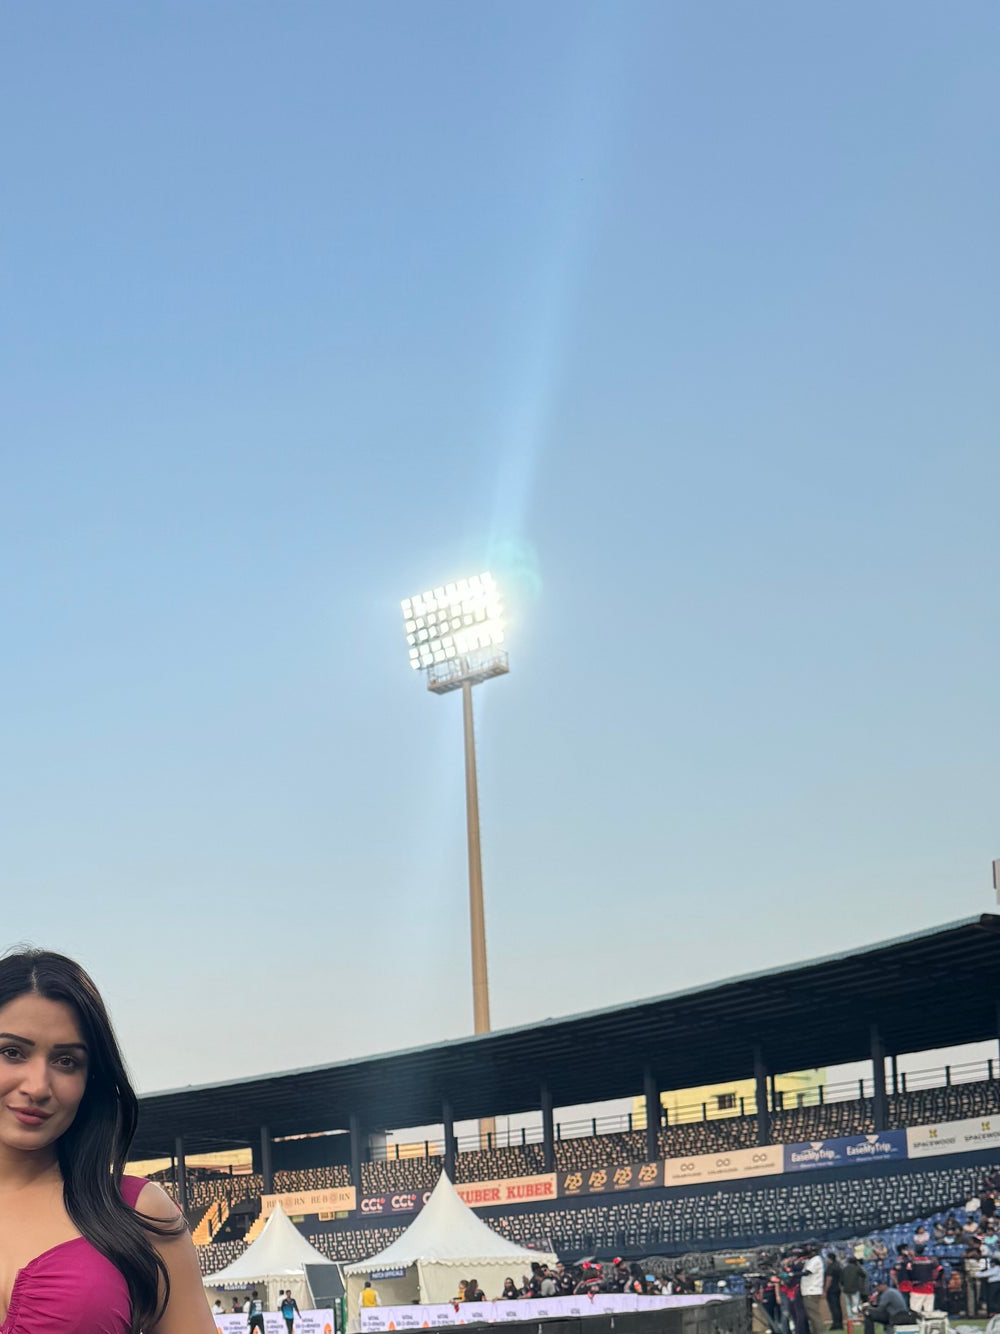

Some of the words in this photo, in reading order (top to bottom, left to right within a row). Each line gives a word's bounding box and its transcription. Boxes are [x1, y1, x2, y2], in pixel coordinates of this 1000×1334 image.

[506, 1182, 553, 1199] KUBER
[361, 1199, 383, 1212] CCL
[391, 1195, 414, 1208] CCL
